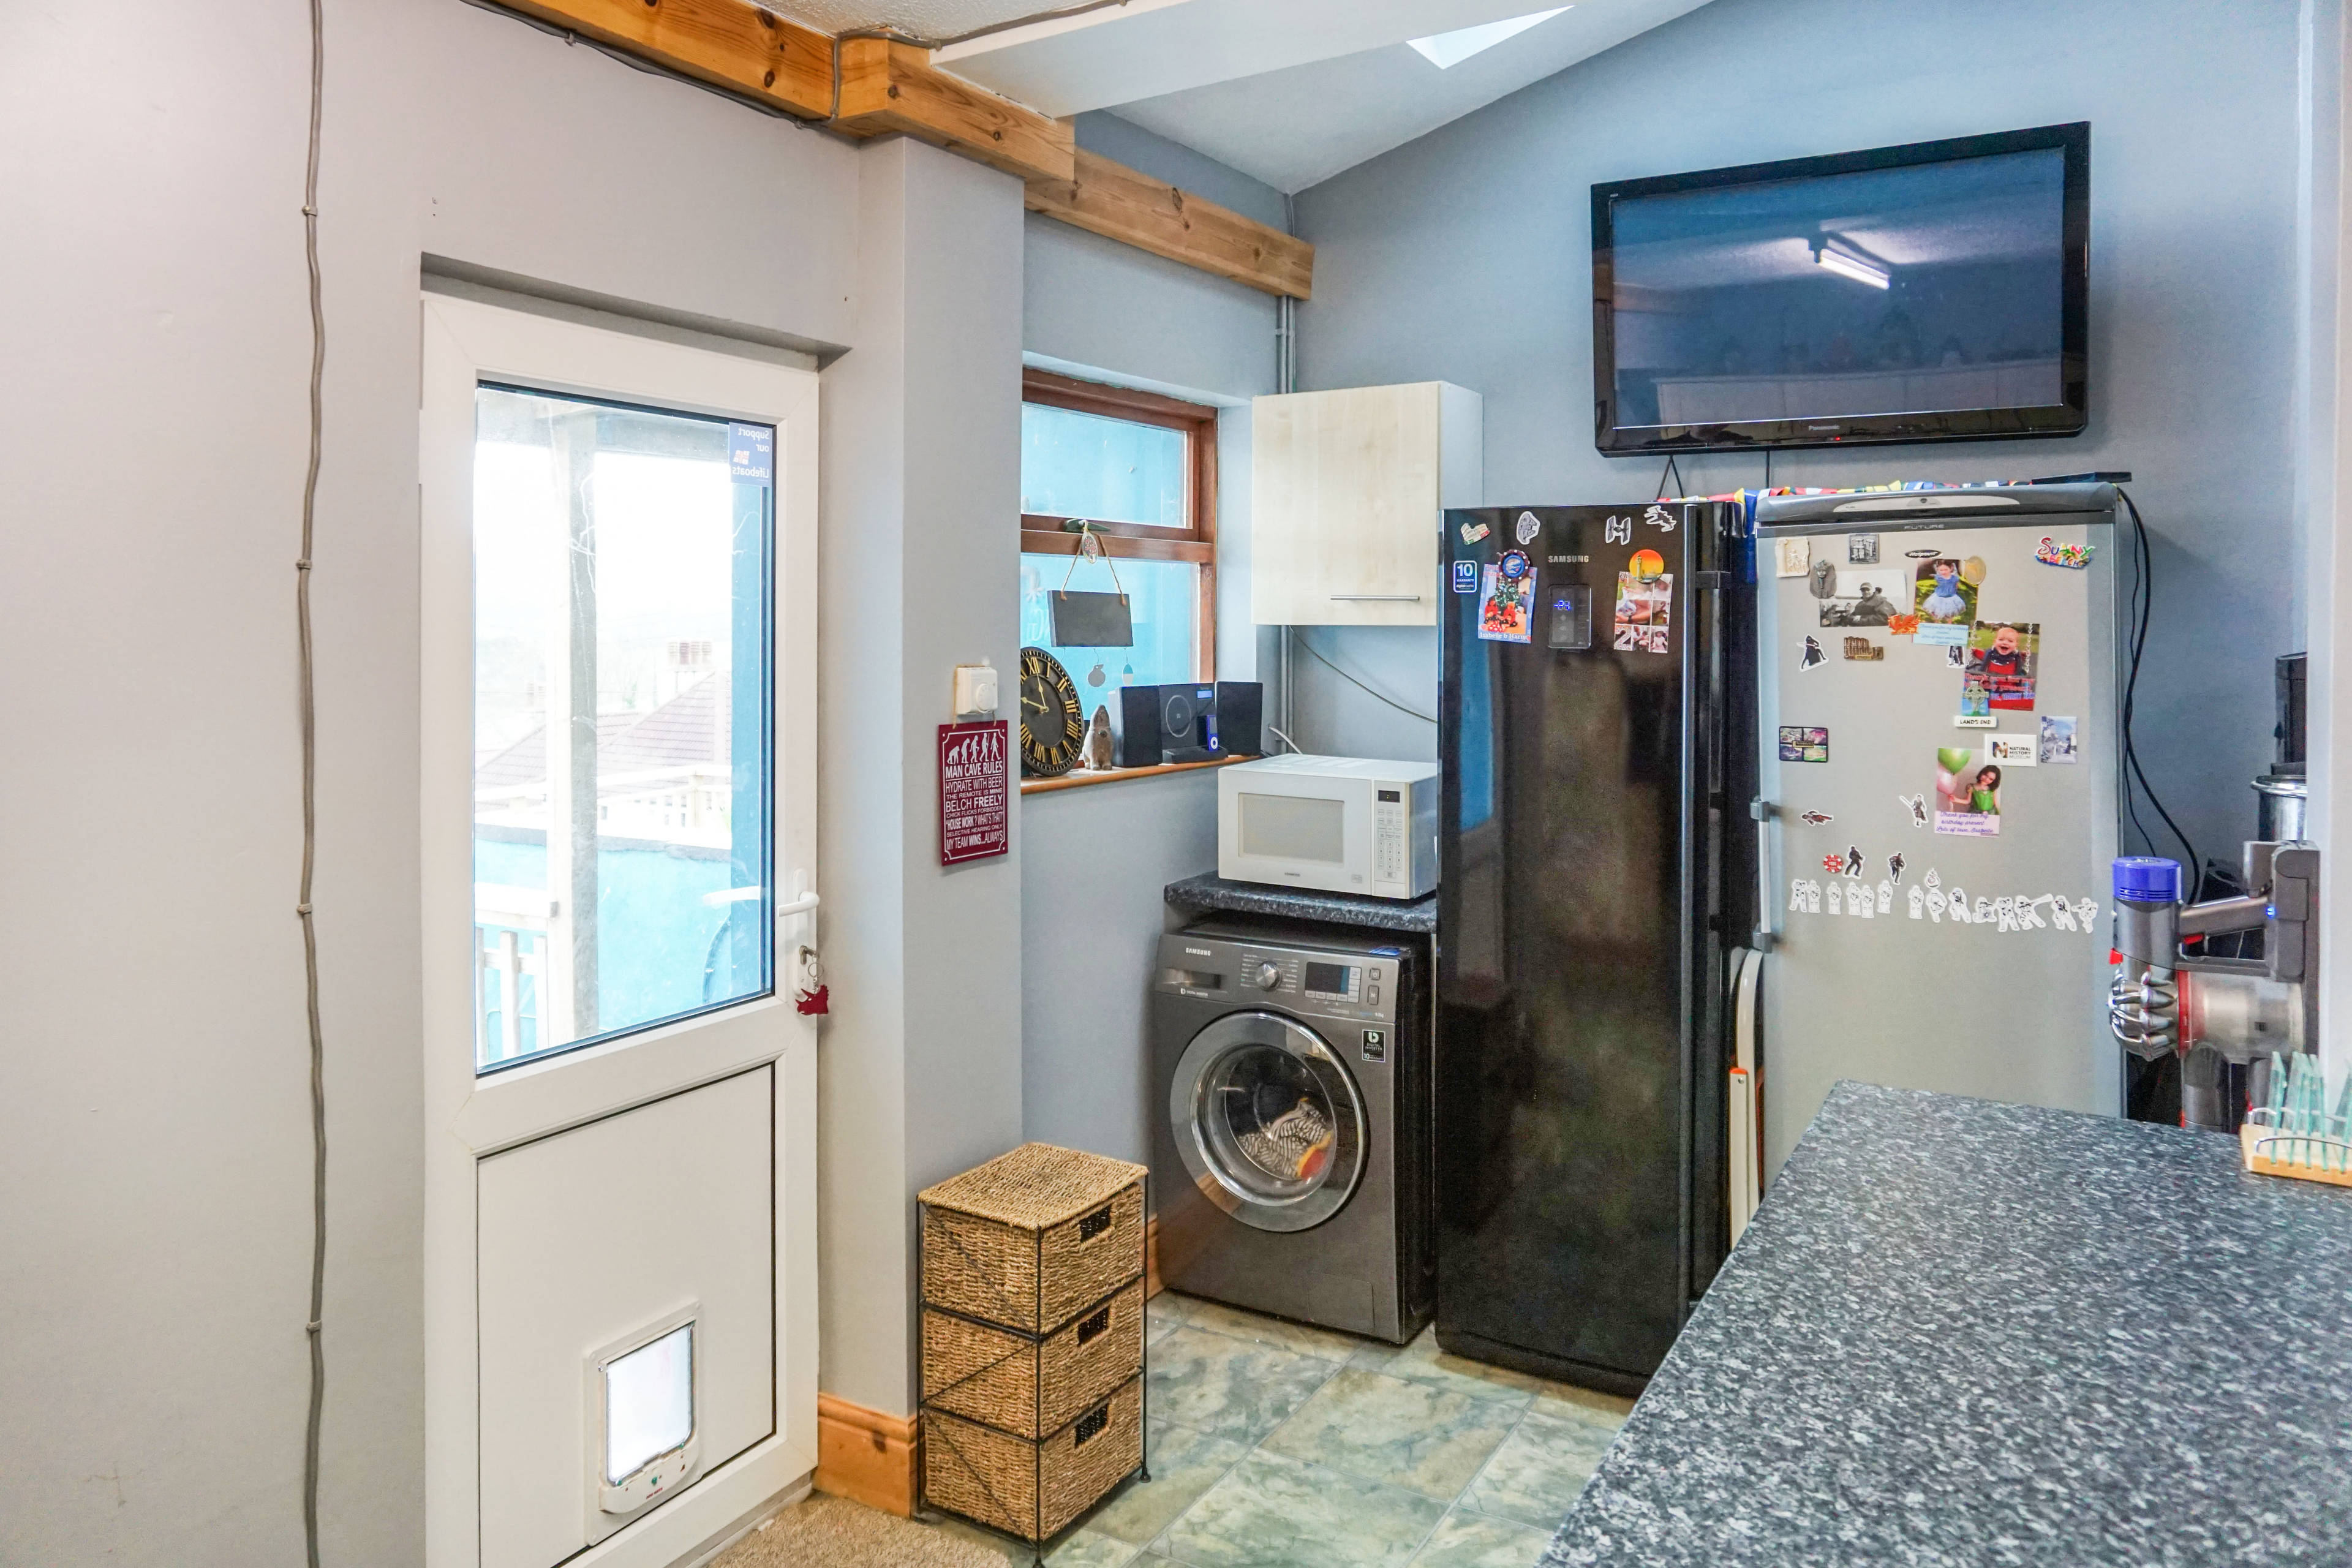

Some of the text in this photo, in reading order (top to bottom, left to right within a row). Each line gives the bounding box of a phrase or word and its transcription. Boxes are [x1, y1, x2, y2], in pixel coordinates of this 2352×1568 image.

[1457, 563, 1473, 577] 10
[945, 760, 1003, 779] MAN CAVE RULES
[945, 776, 1003, 794] HYDRATE WITH BEER
[959, 790, 982, 799] REMOTE
[946, 794, 1003, 813] BELCH FREELY
[978, 805, 1003, 814] FORBIDDEN
[946, 828, 970, 837] SELECTIVE
[946, 838, 954, 850] MY
[954, 835, 968, 849] TEAM
[1185, 947, 1211, 956] SAMSUNG
